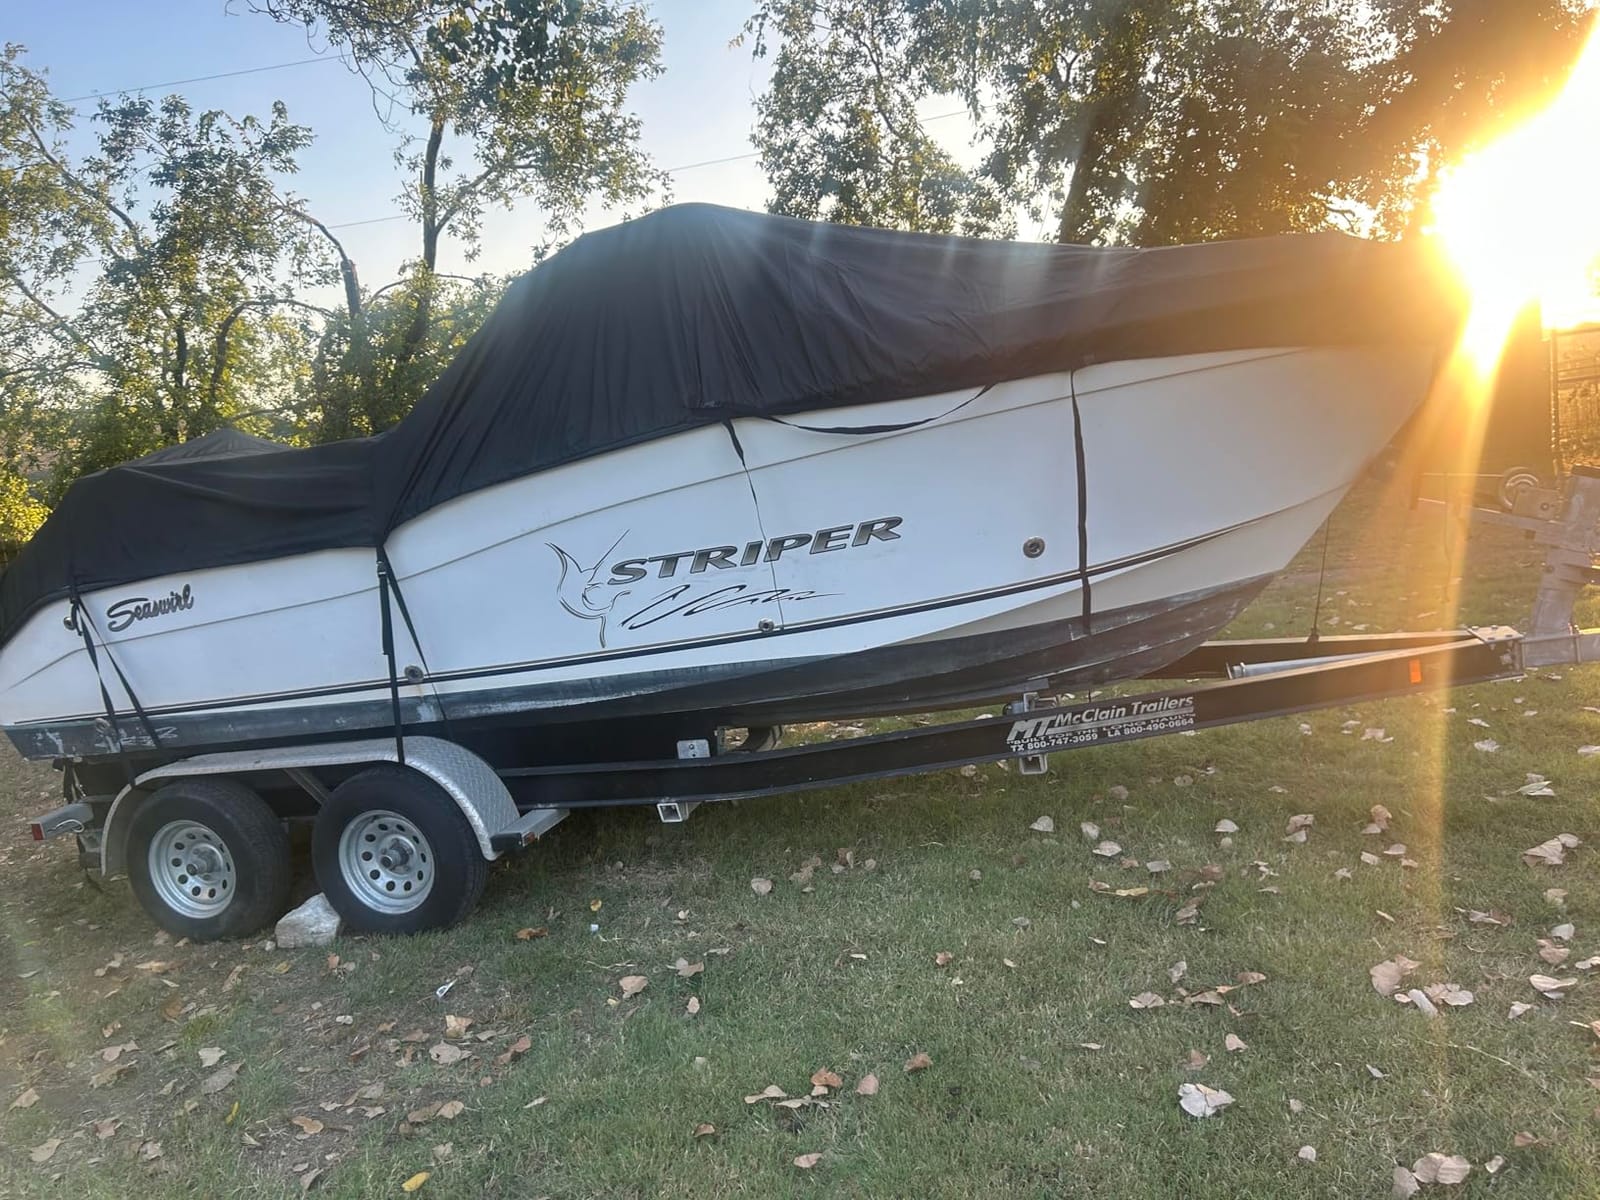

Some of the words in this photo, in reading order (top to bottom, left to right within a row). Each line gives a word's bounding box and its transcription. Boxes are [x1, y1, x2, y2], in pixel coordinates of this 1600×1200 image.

[607, 516, 903, 585] STRIPER
[1054, 705, 1126, 728] McClain
[1131, 696, 1194, 715] Trailers
[1010, 743, 1025, 752] TX
[1027, 732, 1098, 751] 800-747-3059
[1107, 729, 1121, 738] LA
